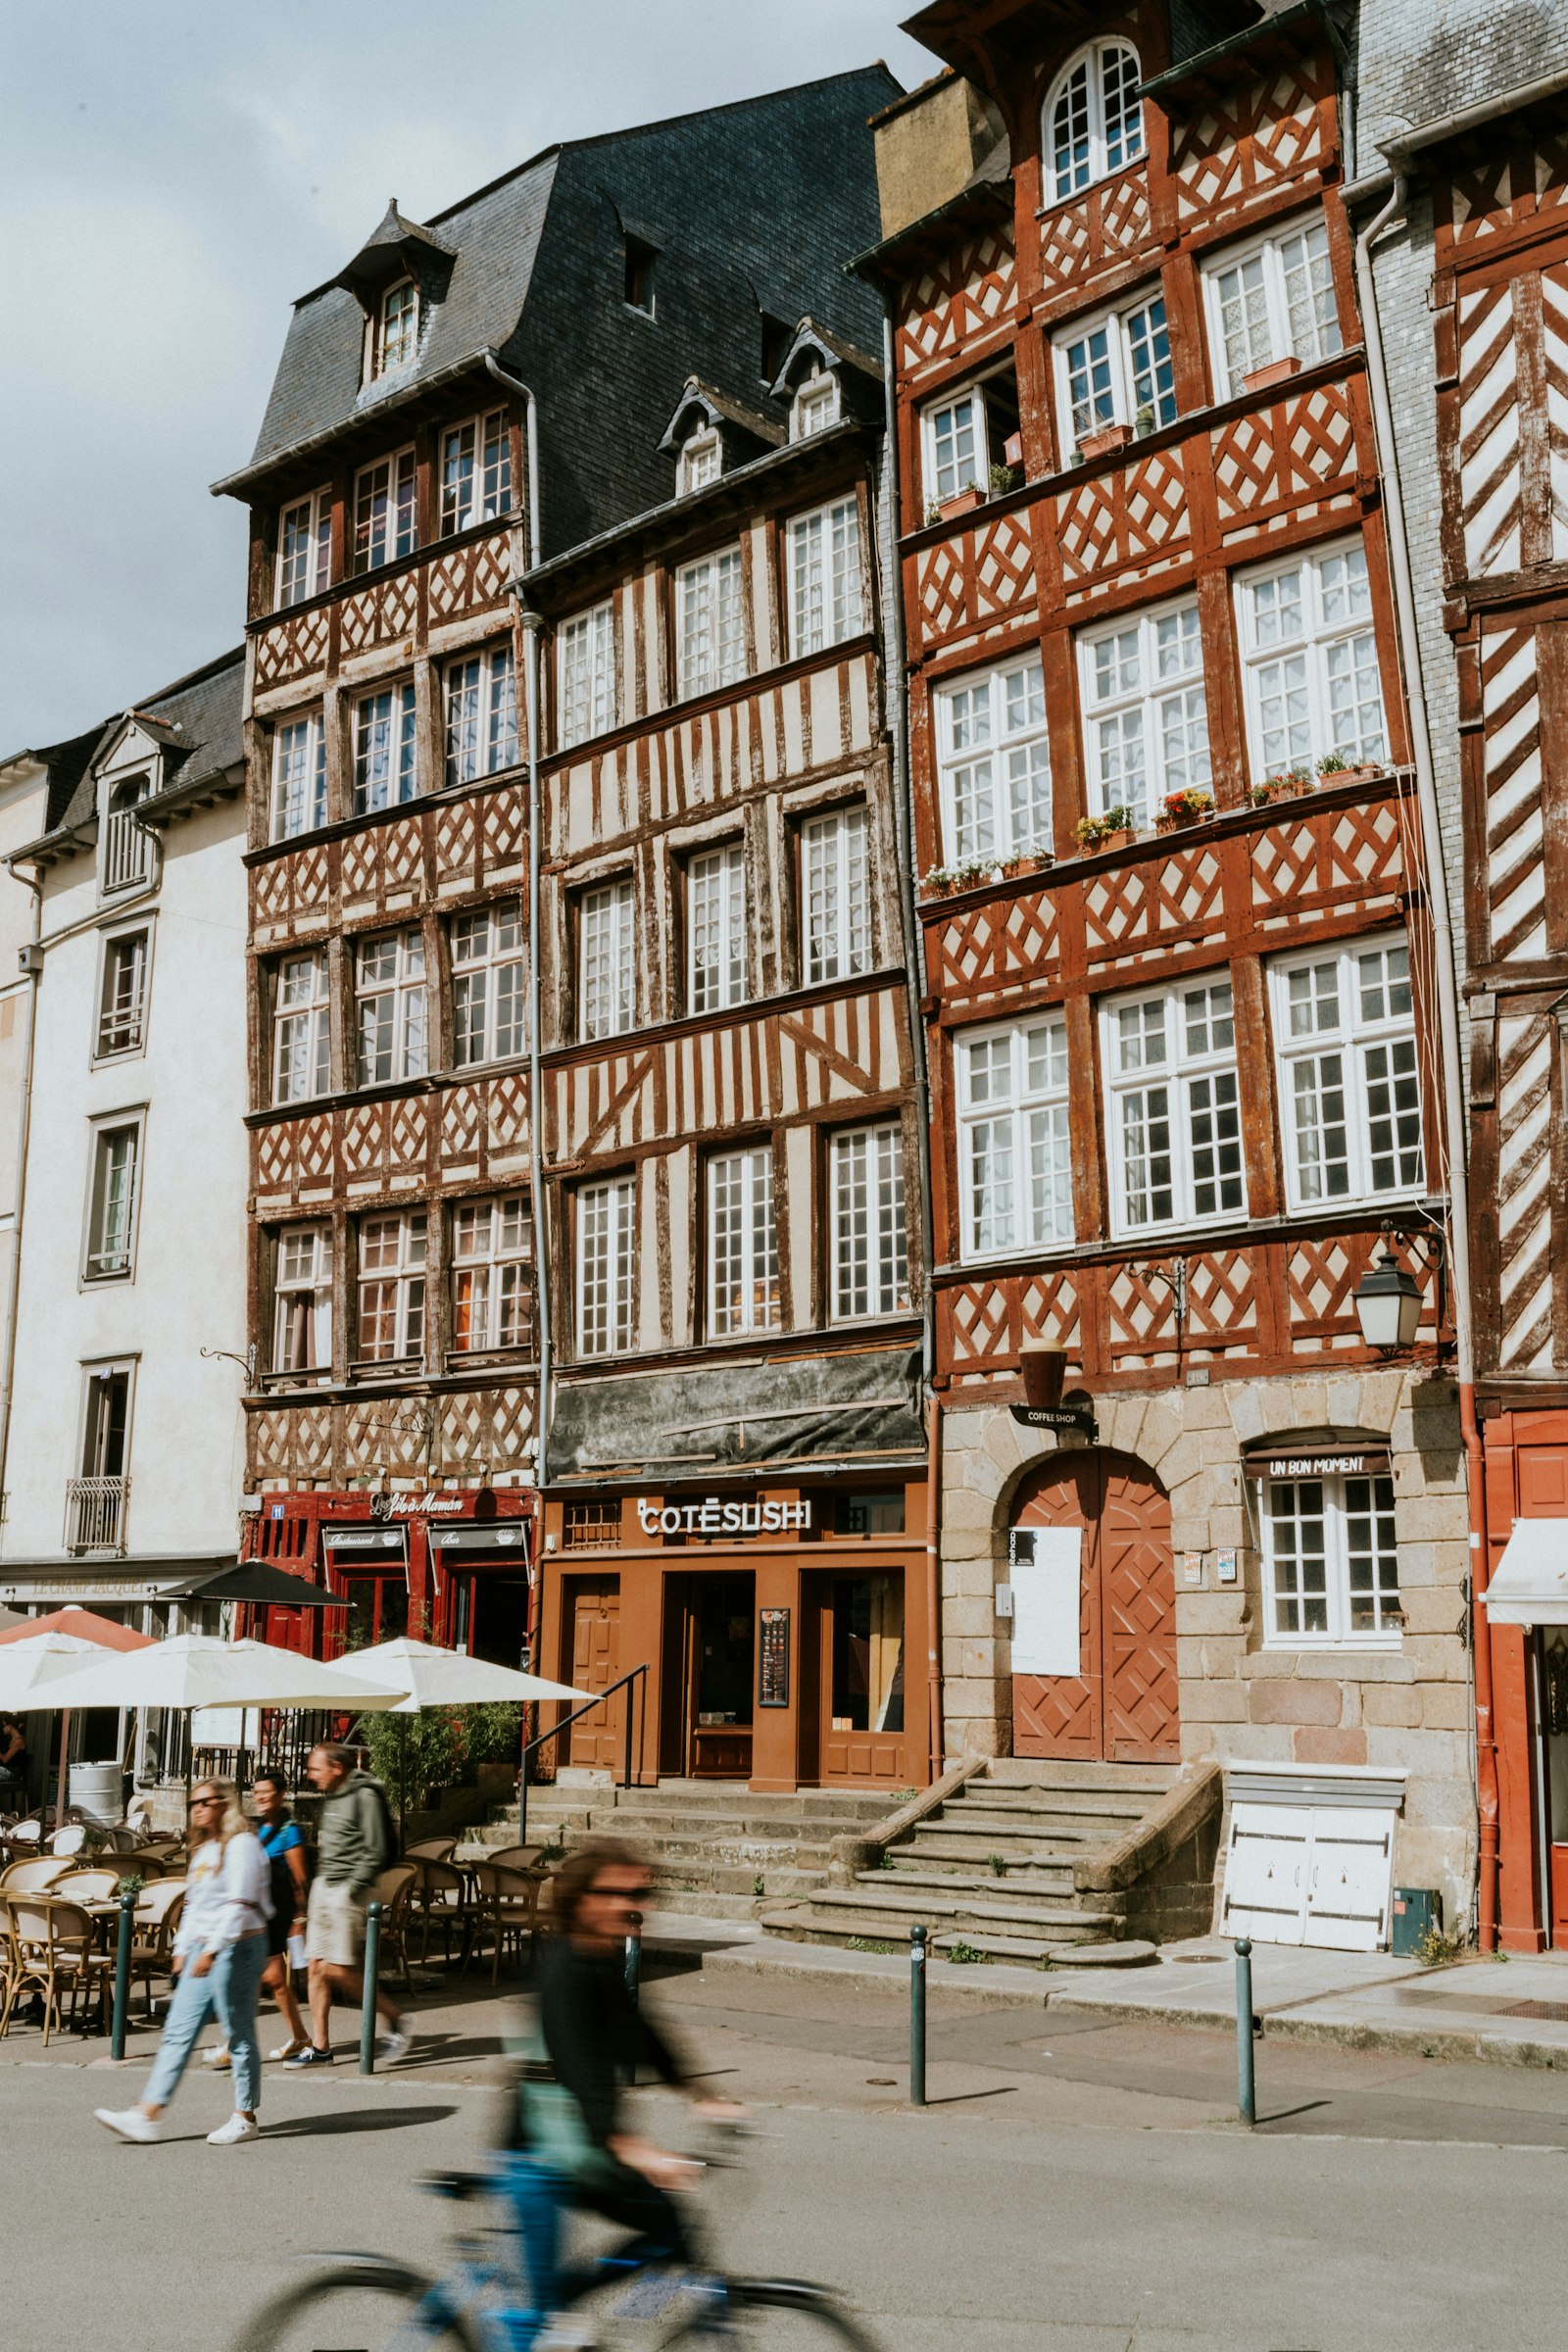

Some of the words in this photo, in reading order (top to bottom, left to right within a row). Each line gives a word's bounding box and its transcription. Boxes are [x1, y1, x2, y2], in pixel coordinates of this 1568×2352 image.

[1028, 1412, 1054, 1422] COFFEE
[1055, 1414, 1076, 1423] SHOP
[1270, 1460, 1285, 1475] UN
[1288, 1459, 1311, 1474] BON
[1314, 1456, 1364, 1473] MOMENT
[416, 1492, 464, 1512] Maman
[328, 1533, 375, 1545] Restaurant
[441, 1532, 460, 1544] Bar
[33, 1579, 47, 1594] LE
[50, 1577, 90, 1594] CHAMP
[92, 1576, 146, 1595] JACQUET
